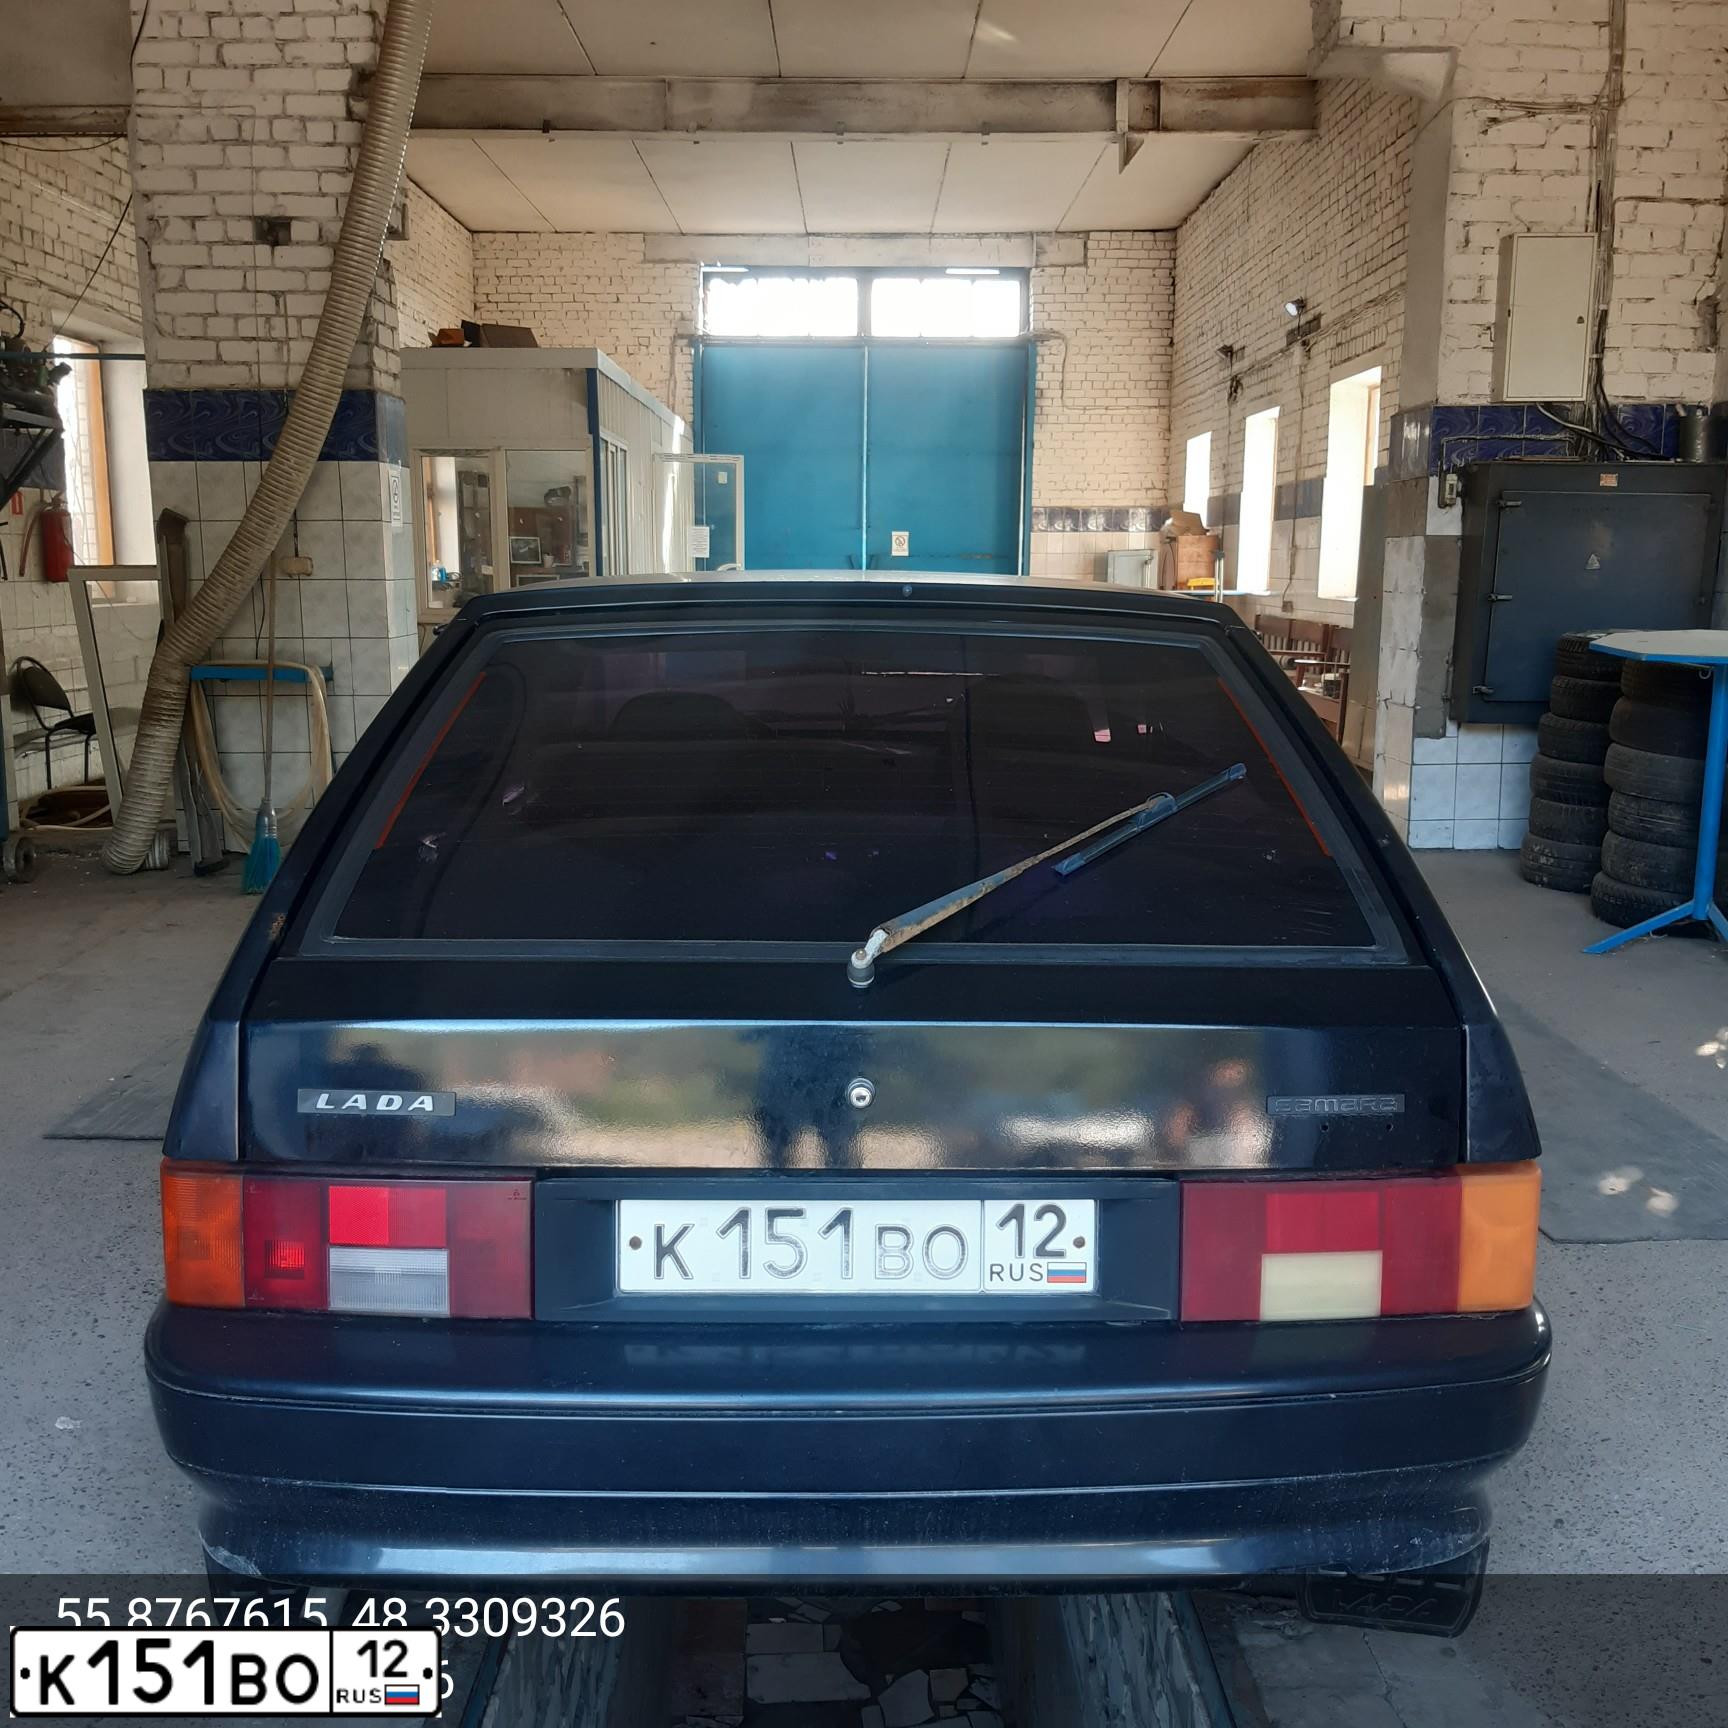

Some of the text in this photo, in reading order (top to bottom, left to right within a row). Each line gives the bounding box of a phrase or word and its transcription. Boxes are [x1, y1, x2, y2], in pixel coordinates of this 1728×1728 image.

[315, 1093, 434, 1112] LADA
[995, 1203, 1068, 1259] 12
[989, 1263, 1044, 1283] RUS
